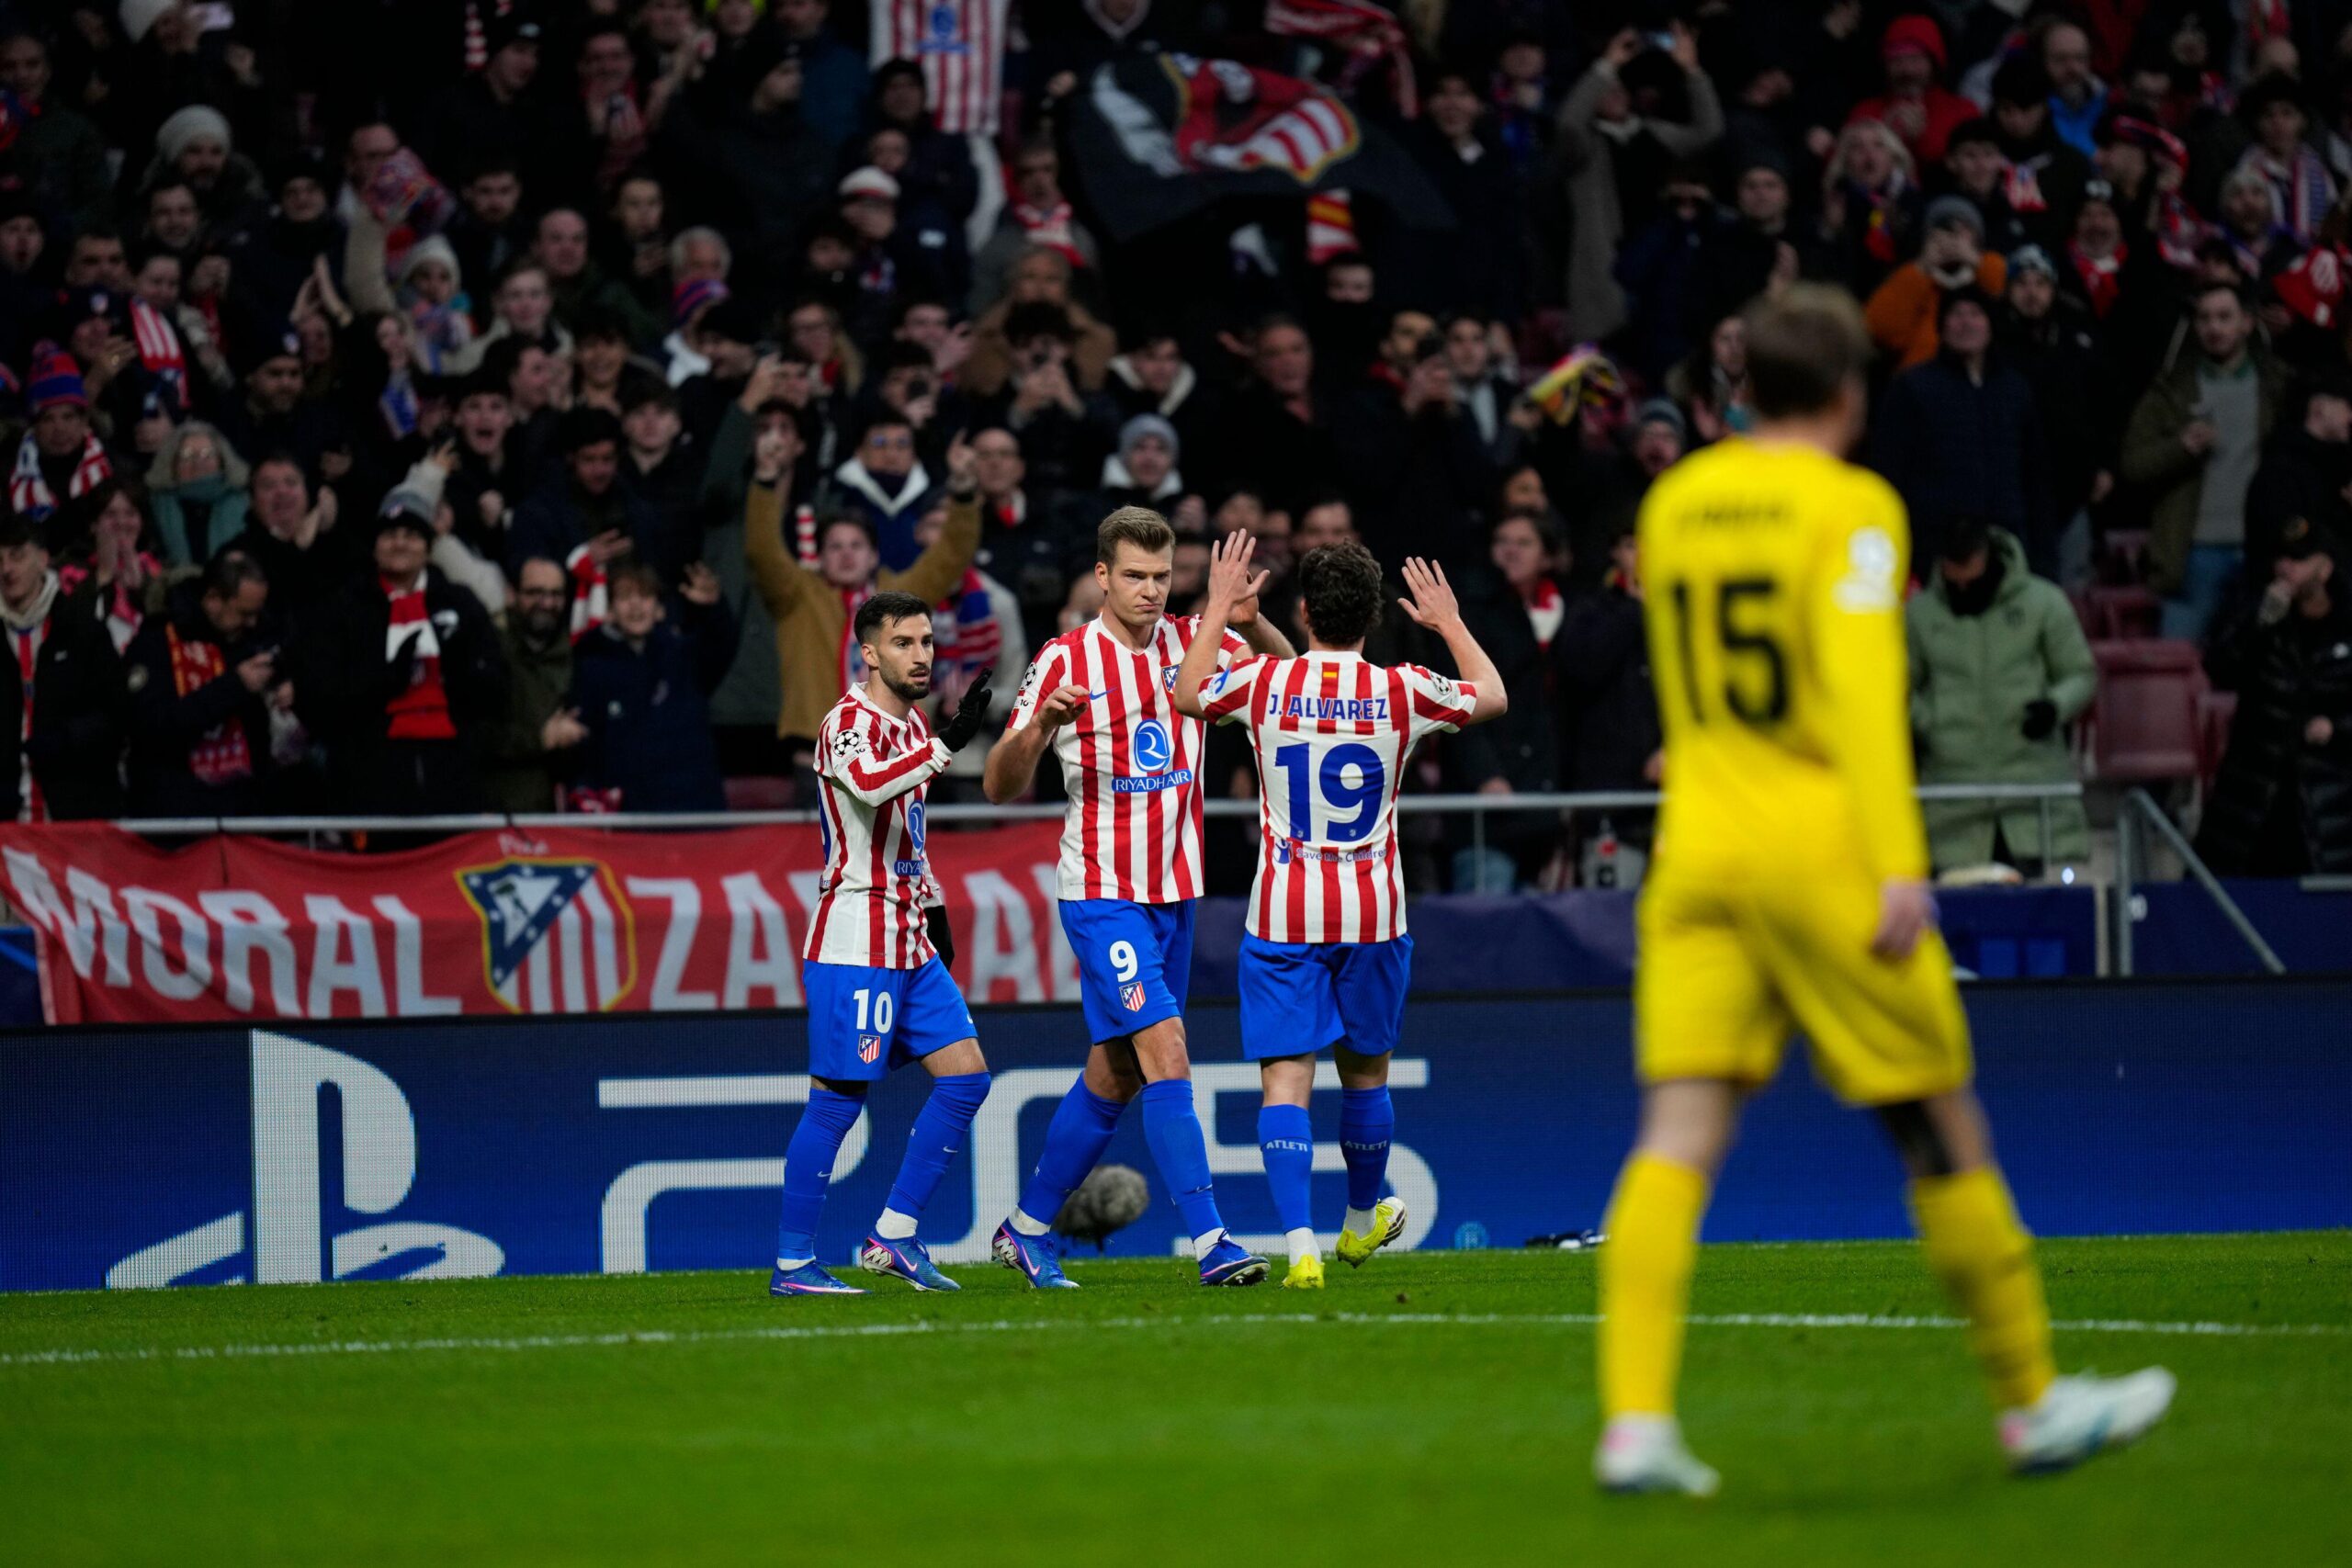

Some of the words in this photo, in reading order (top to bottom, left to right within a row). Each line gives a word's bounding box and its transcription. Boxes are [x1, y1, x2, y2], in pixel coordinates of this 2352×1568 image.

[1671, 577, 1789, 728] 15
[1269, 694, 1283, 716] J.
[1286, 695, 1388, 721] ALVAREZ
[1115, 776, 1165, 791] RIYADH
[1167, 771, 1190, 786] AIR
[1274, 742, 1385, 842] 19
[897, 861, 923, 874] RIYA
[1296, 848, 1322, 861] Save
[2, 844, 462, 1018] MORAL
[626, 863, 1083, 1011] ZAAL
[1109, 940, 1138, 983] 9
[853, 988, 893, 1034] 10
[1266, 1139, 1308, 1152] ATLETI
[1344, 1140, 1387, 1151] ATLETI
[598, 1058, 1439, 1277] PS5
